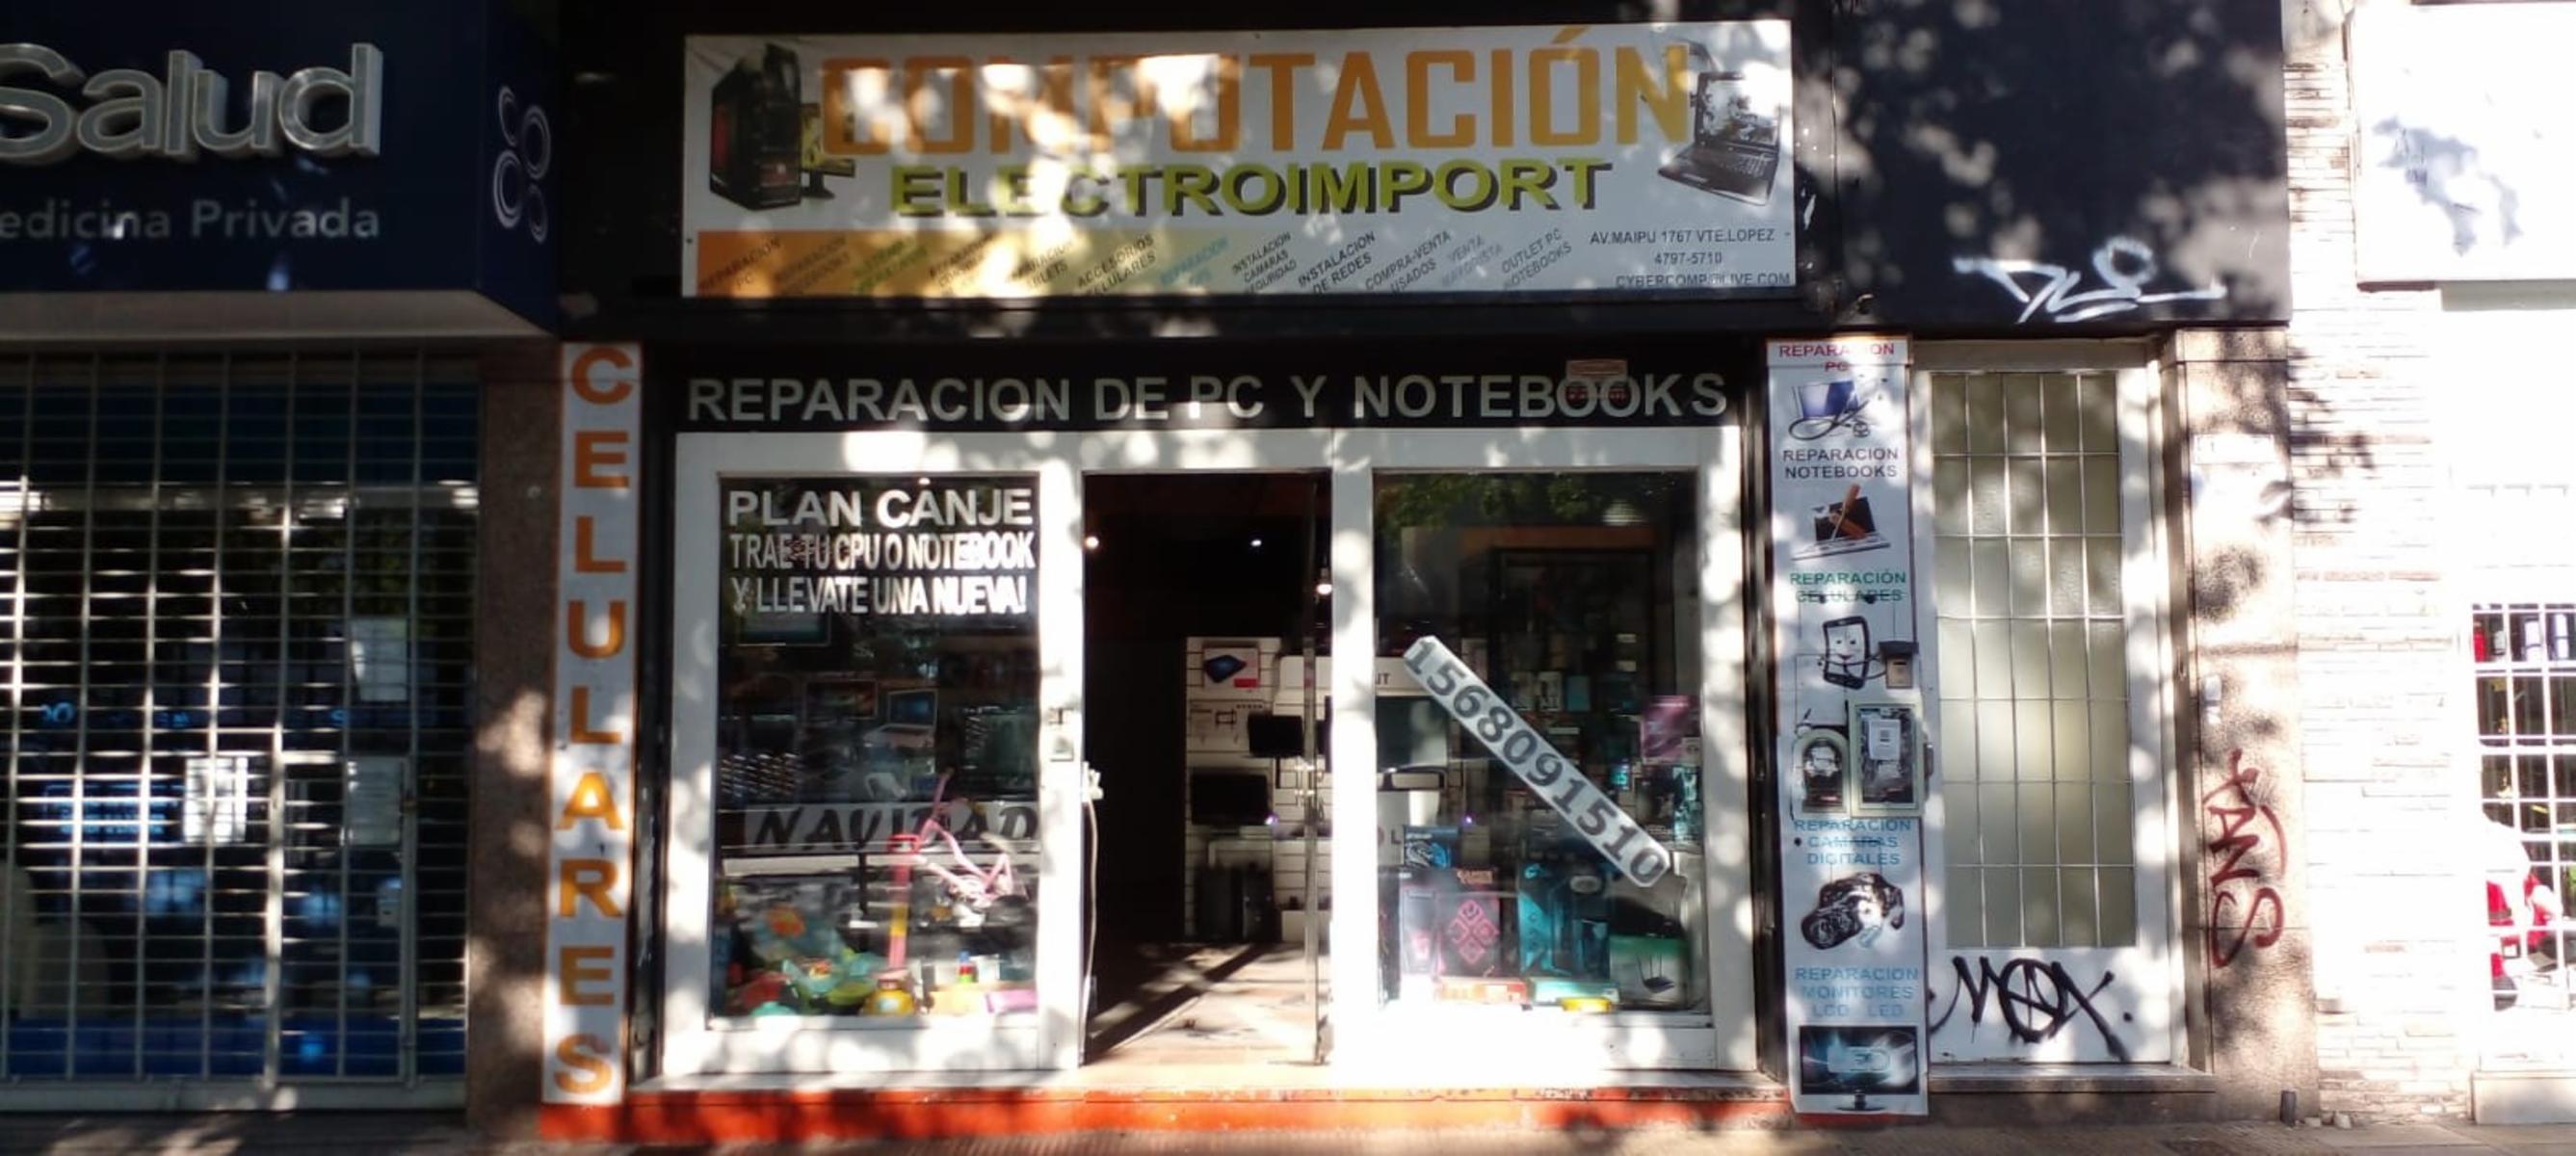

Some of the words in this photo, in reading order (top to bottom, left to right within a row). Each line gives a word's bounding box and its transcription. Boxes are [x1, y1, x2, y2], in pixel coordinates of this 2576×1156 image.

[0, 42, 382, 165] Salud
[822, 26, 1692, 155] COMPUTACIÓN
[889, 157, 1613, 218] ELECTROIMPORT
[193, 198, 380, 239] Privada
[1590, 229, 1656, 246] AV.MAIPU
[1661, 229, 1692, 244] 1767
[1077, 232, 1155, 288] ACCESORIOS
[1231, 230, 1292, 275] INSTALACION
[1244, 249, 1289, 284] CAMARAS
[1298, 230, 1377, 288] INSTALACION
[1331, 250, 1373, 284] REDES
[1364, 230, 1452, 292] COMPRA-VENTA
[1448, 233, 1485, 264] VENTA
[1501, 238, 1544, 275] OUTLET
[1544, 227, 1564, 245] PC
[1654, 250, 1723, 266] 4797-5710
[1390, 257, 1437, 295] USADOS
[1778, 343, 1895, 357] REPARAON
[1824, 361, 1850, 372] PC
[688, 378, 1069, 422] REPARACION
[1094, 377, 1169, 421] DE
[1189, 375, 1264, 420] PC
[1290, 375, 1327, 418] Y
[1354, 373, 1727, 419] NOTEBOOKS
[1783, 447, 1899, 462] REPARACION
[1785, 462, 1898, 480] NOTEBOOKS
[729, 489, 861, 527] PLAN
[877, 487, 1034, 528] CANJE
[729, 533, 794, 569] TRAE
[801, 533, 830, 569] TU
[834, 533, 881, 570] CPU
[884, 533, 904, 570] O
[907, 531, 1036, 570] NOTEBOOK
[730, 576, 750, 614] Y
[756, 575, 868, 614] LLEVATE
[873, 575, 930, 615] UNA
[553, 346, 634, 1095] CELULARES
[1404, 640, 1668, 884] 1568091510
[1806, 852, 1901, 865] DIGITALES
[1795, 966, 1918, 981] REPARACION
[1802, 985, 1913, 1000] MONITORES
